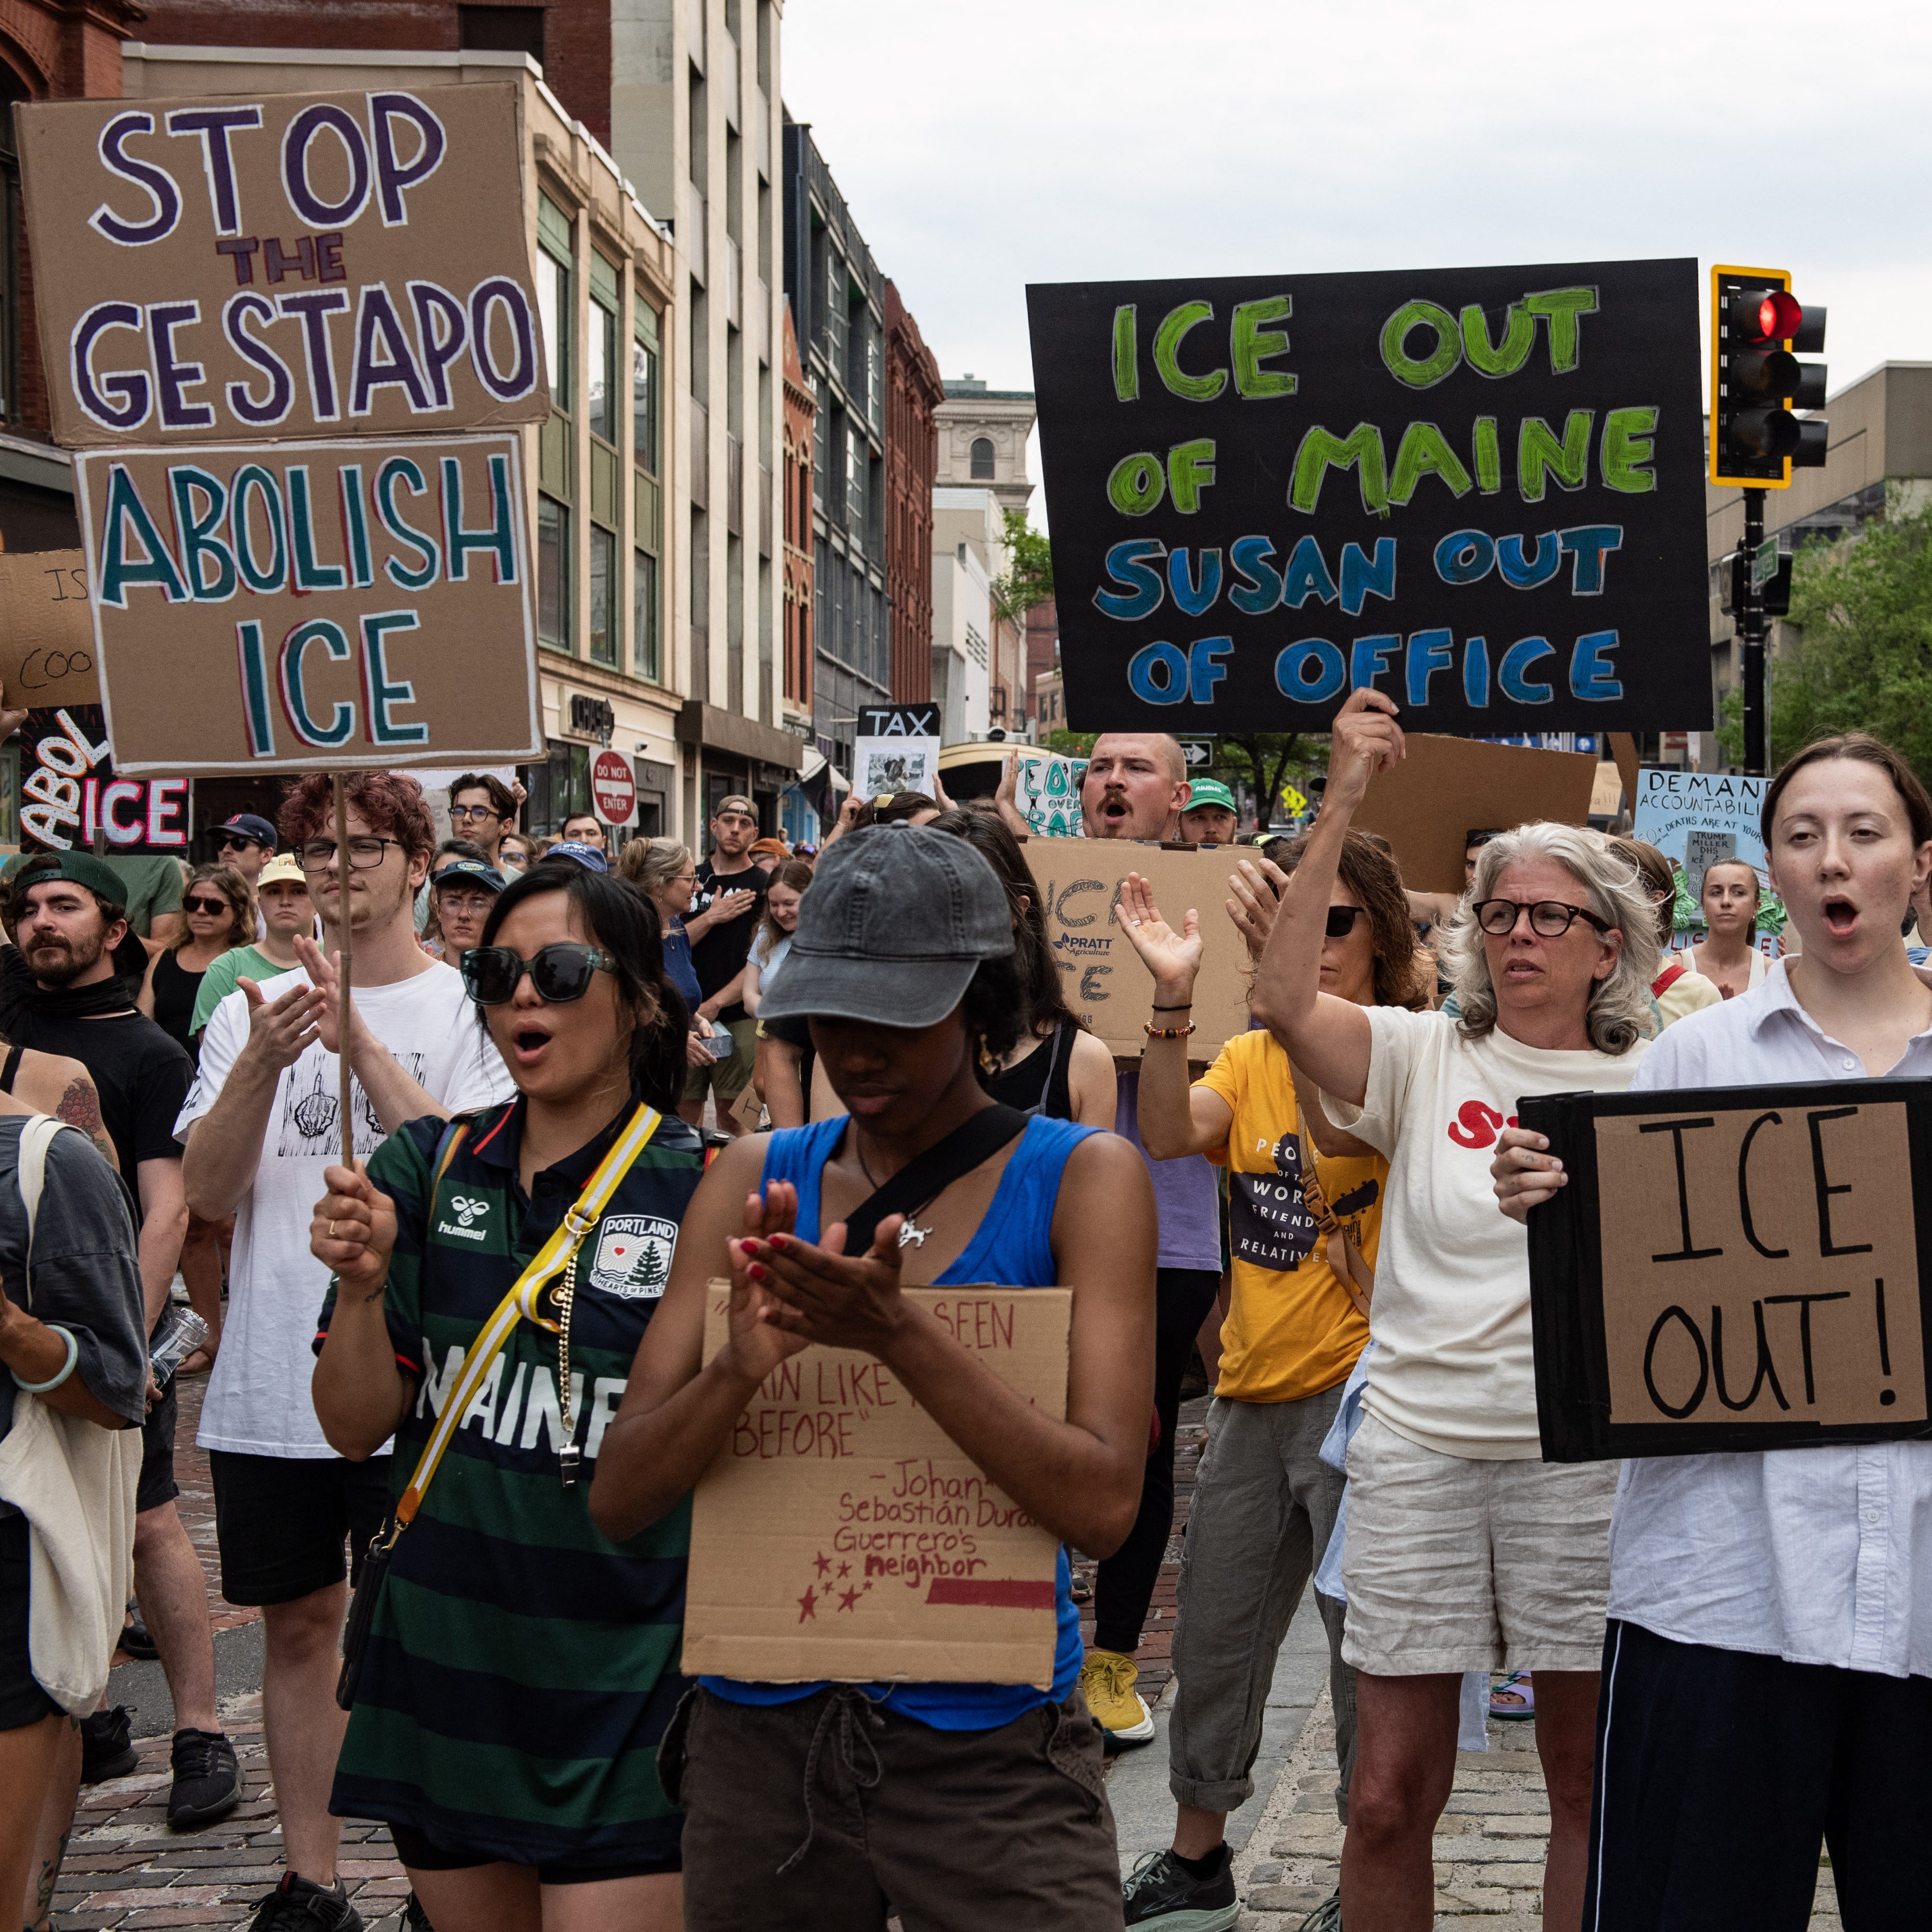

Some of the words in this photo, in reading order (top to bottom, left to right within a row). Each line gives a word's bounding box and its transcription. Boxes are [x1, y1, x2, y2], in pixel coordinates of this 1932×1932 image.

[88, 92, 447, 247] STOP
[216, 233, 347, 285] THE
[70, 275, 538, 433] GESTAPO
[1112, 294, 1299, 402] ICE
[1379, 285, 1599, 390] OUT
[1107, 438, 1216, 516] OF
[1287, 405, 1660, 517] MAINE
[98, 453, 519, 609] ABOLISH
[44, 568, 88, 601] IS
[1092, 535, 1397, 621] SUSAN
[1434, 525, 1624, 596] OUT
[20, 648, 92, 688] COO
[236, 609, 430, 758] ICE
[1127, 635, 1234, 706] OF
[1275, 628, 1624, 708] OFFICE
[866, 710, 933, 736] TAX
[20, 708, 111, 851] ABOL
[597, 765, 608, 778] DO
[611, 767, 627, 779] NOT
[1018, 759, 1089, 798] EOP
[82, 778, 188, 846] ICE
[603, 796, 628, 811] ENTER
[1048, 799, 1080, 810] OVER
[1640, 793, 1764, 816] ACCOUNTABILI
[1666, 816, 1697, 832] DEATHS
[1701, 818, 1720, 828] ARE
[1743, 824, 1762, 844] YOUR
[1693, 840, 1730, 848] MILLER
[1695, 832, 1726, 840] TRUMP
[1069, 947, 1110, 957] Agriculture
[1070, 937, 1113, 949] PRATT
[1448, 1100, 1519, 1150] S
[1255, 1138, 1319, 1164] PEOE
[1277, 1170, 1289, 1178] OF
[1638, 1105, 1874, 1263] ICE
[1253, 1180, 1303, 1205] WOR
[438, 1221, 487, 1241] hummel
[605, 1218, 675, 1239] PORTLAND
[1252, 1204, 1314, 1228] FRIEND
[1274, 1231, 1294, 1240] AND
[598, 1277, 628, 1293] HEARTS
[639, 1286, 658, 1294] PINE
[1644, 1277, 1897, 1420] OUT!
[818, 1361, 897, 1406] LIKE
[976, 1498, 1040, 1528] Dura
[864, 1553, 987, 1589] neighbor
